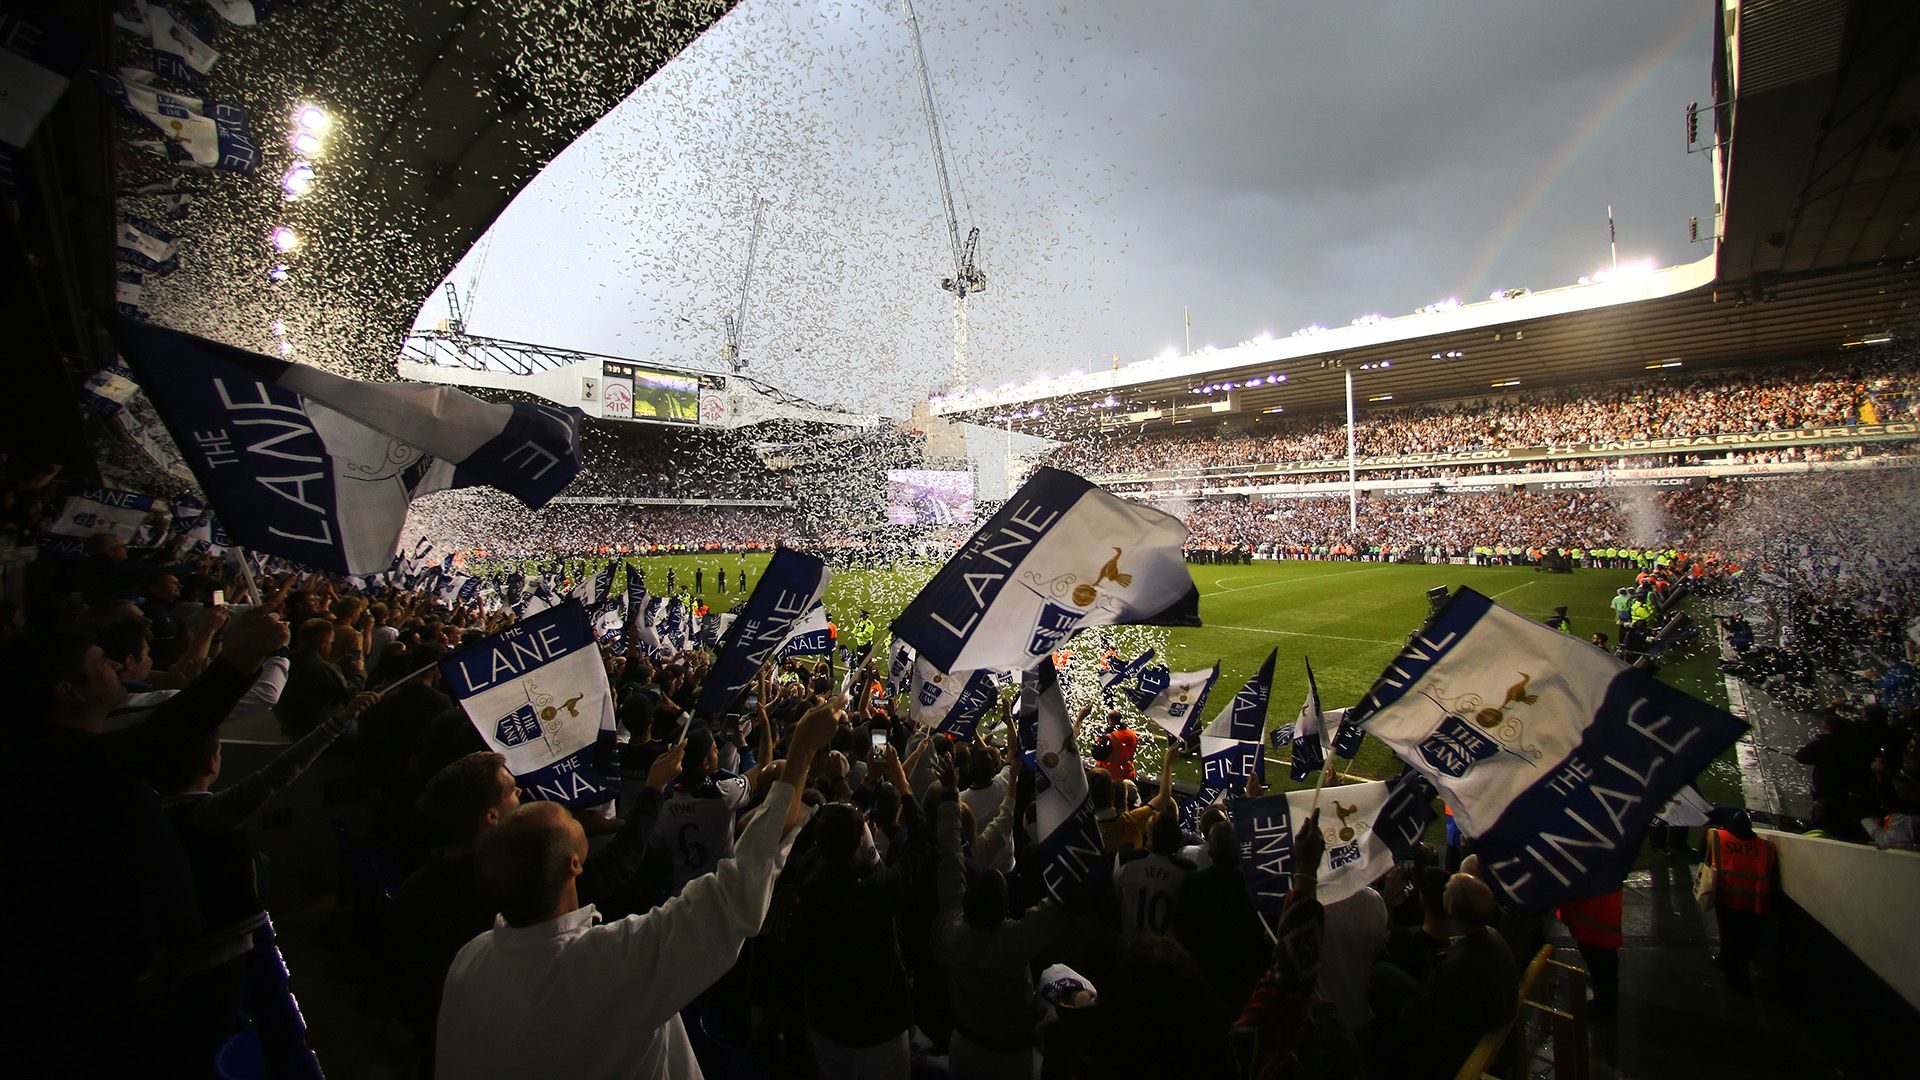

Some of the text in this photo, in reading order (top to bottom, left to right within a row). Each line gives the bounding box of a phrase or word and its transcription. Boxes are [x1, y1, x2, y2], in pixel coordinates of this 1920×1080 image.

[606, 401, 630, 413] AIA
[193, 428, 240, 469] THE
[212, 377, 333, 546] LANE
[1675, 468, 1713, 476] COMPANY
[81, 489, 138, 509] LANE
[960, 532, 993, 561] THE
[930, 499, 1059, 639] LANE
[499, 627, 524, 642] THE
[736, 620, 761, 648] THE
[459, 623, 568, 692] LANE
[777, 635, 827, 663] FINALE
[960, 690, 972, 705] THE
[500, 718, 519, 746] LANE
[521, 711, 538, 734] THE
[1451, 724, 1485, 753] THE
[552, 755, 581, 776] THE
[1421, 739, 1466, 777] LANE
[1543, 756, 1594, 797] THE
[1487, 696, 1702, 905] FINALE
[678, 822, 710, 869] 6
[1240, 840, 1253, 860] THE
[1253, 813, 1293, 898] LANE
